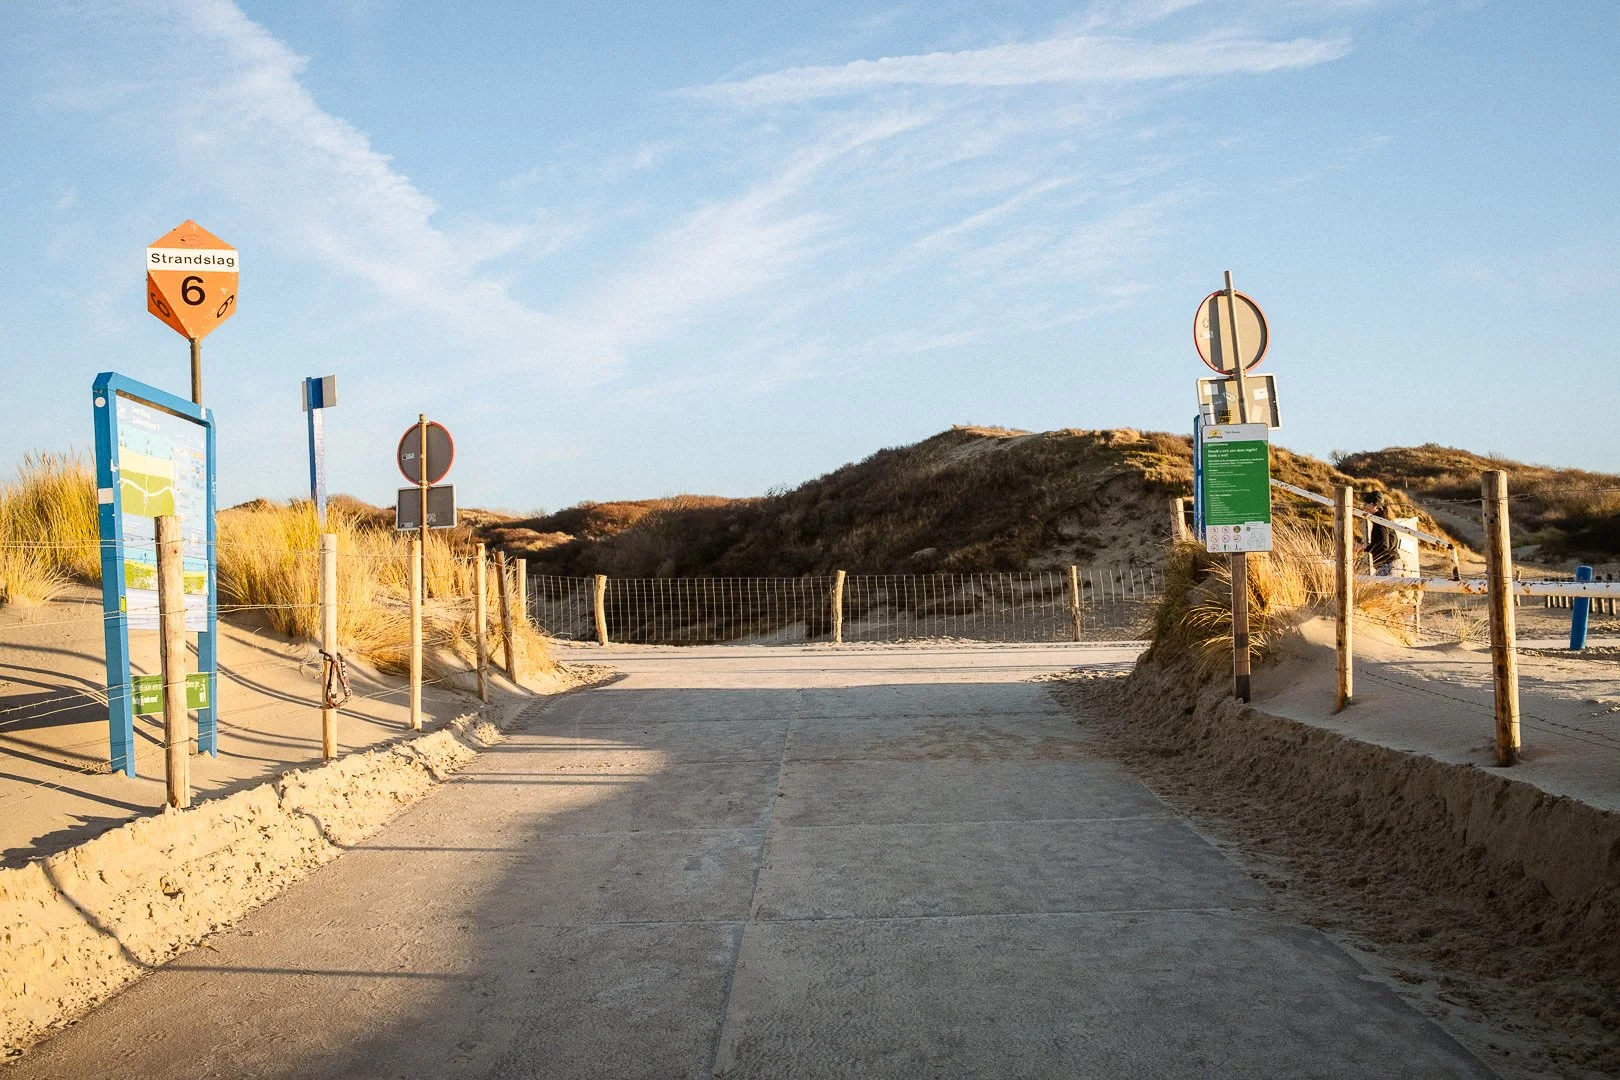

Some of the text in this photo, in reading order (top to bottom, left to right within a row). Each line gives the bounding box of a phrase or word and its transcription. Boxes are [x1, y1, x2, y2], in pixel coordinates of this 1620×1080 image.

[151, 253, 235, 268] Strandslag
[181, 275, 206, 306] 6
[150, 292, 171, 318] 6
